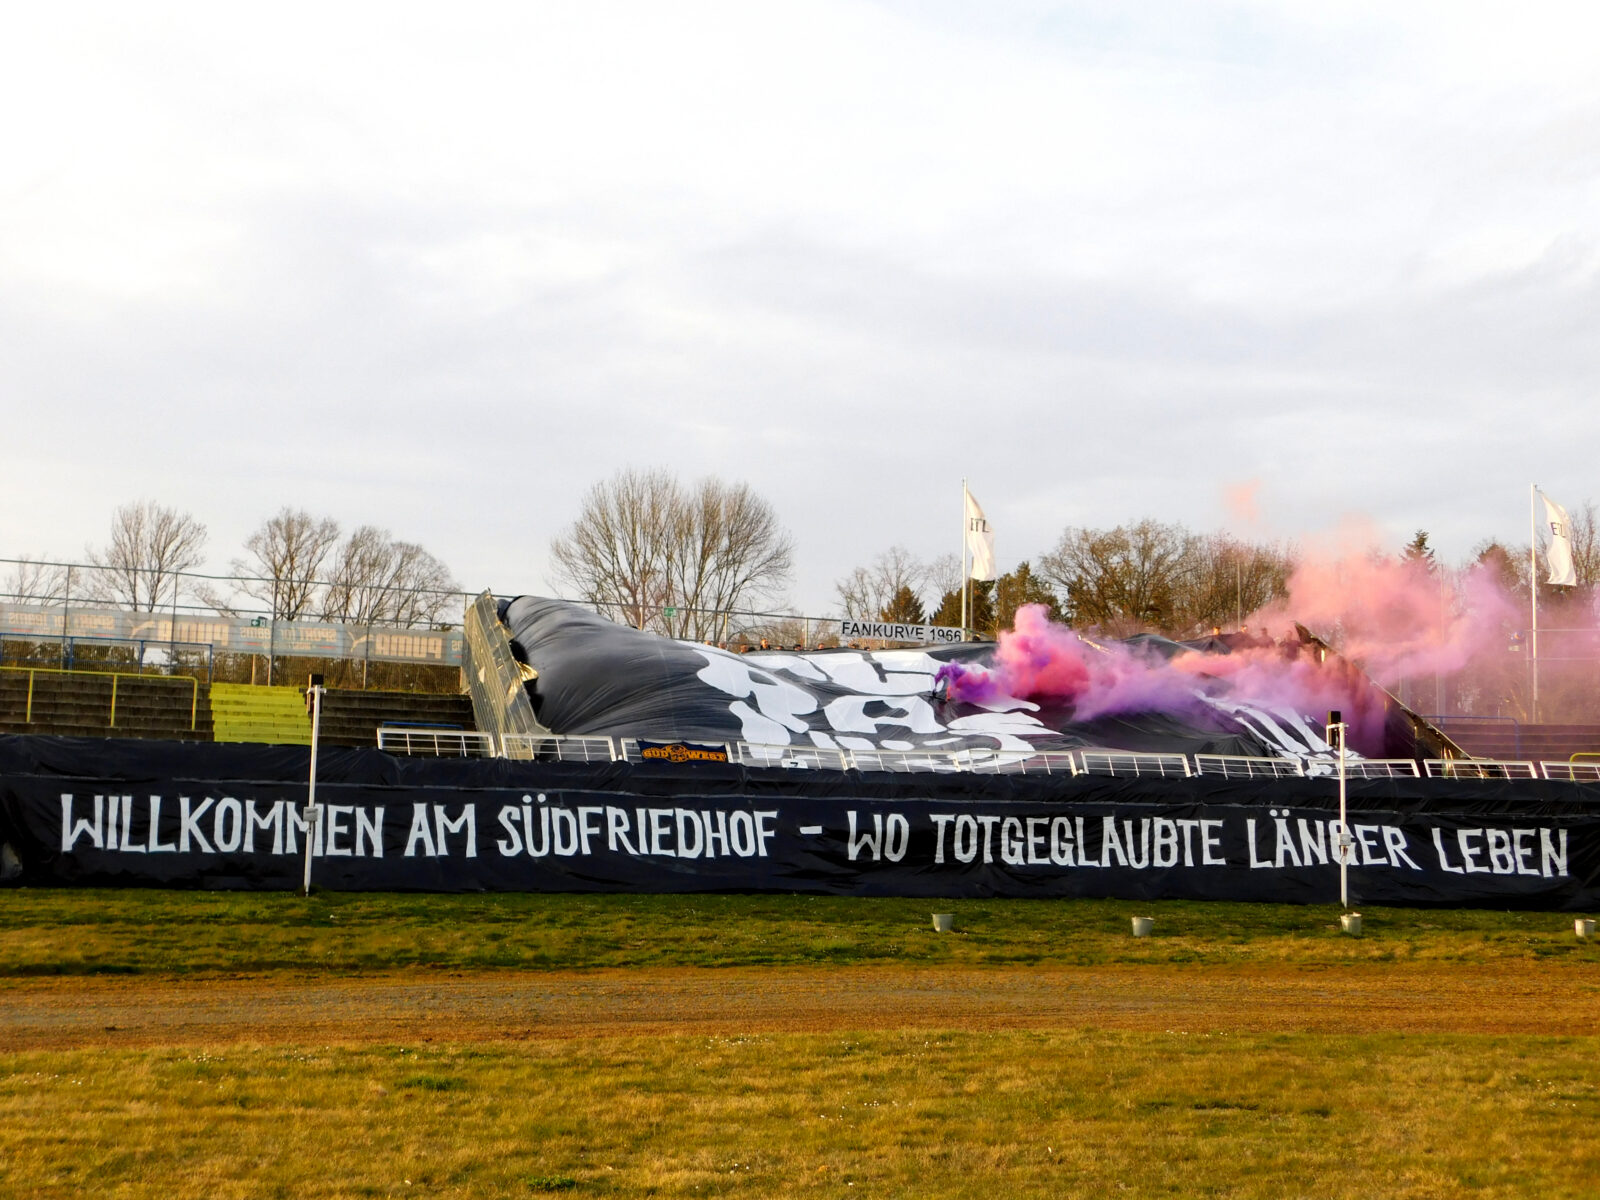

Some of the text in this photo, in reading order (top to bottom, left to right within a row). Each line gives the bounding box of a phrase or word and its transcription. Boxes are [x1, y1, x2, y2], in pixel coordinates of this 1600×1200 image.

[842, 621, 962, 643] FANKURVE 1966
[61, 794, 385, 858] WILLKOMMEN
[404, 803, 477, 858] AM
[497, 794, 778, 860] SÜDFRIEDHOF
[847, 810, 910, 862] WO
[929, 814, 1227, 869] TOTGEGLAUBTE
[1247, 809, 1423, 871] LÄNGER
[1432, 827, 1569, 878] LEBEN
